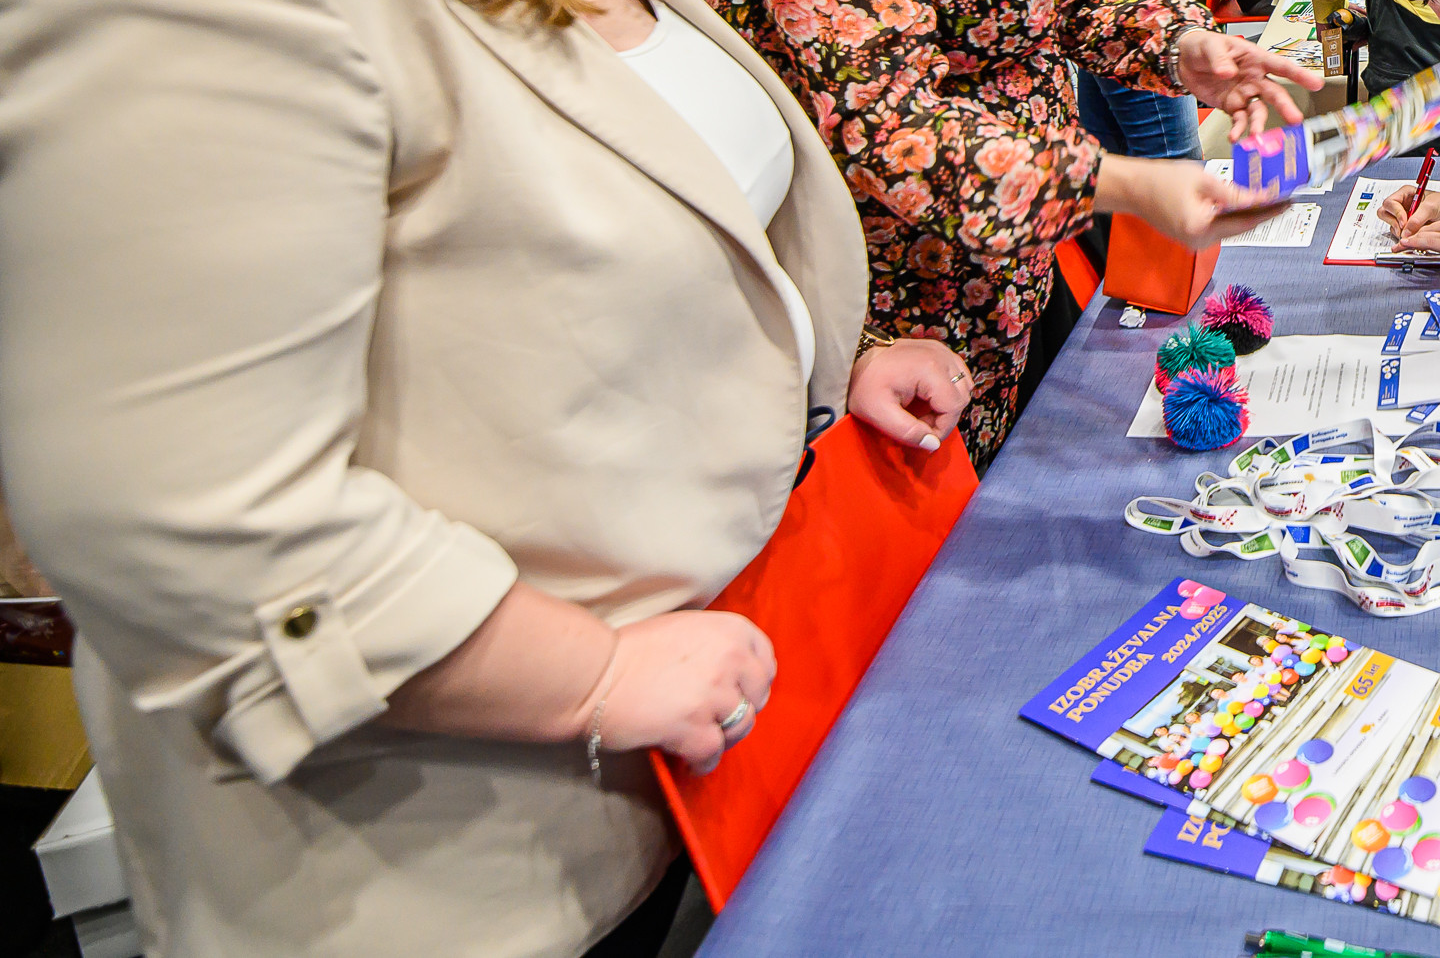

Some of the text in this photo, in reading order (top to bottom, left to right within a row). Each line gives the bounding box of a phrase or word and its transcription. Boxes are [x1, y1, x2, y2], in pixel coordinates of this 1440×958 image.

[1048, 604, 1182, 715] IZOBRAŽEVALNA
[1161, 604, 1228, 664] 2024/2025
[1066, 652, 1155, 723] PONUDBA
[1352, 676, 1374, 696] 65
